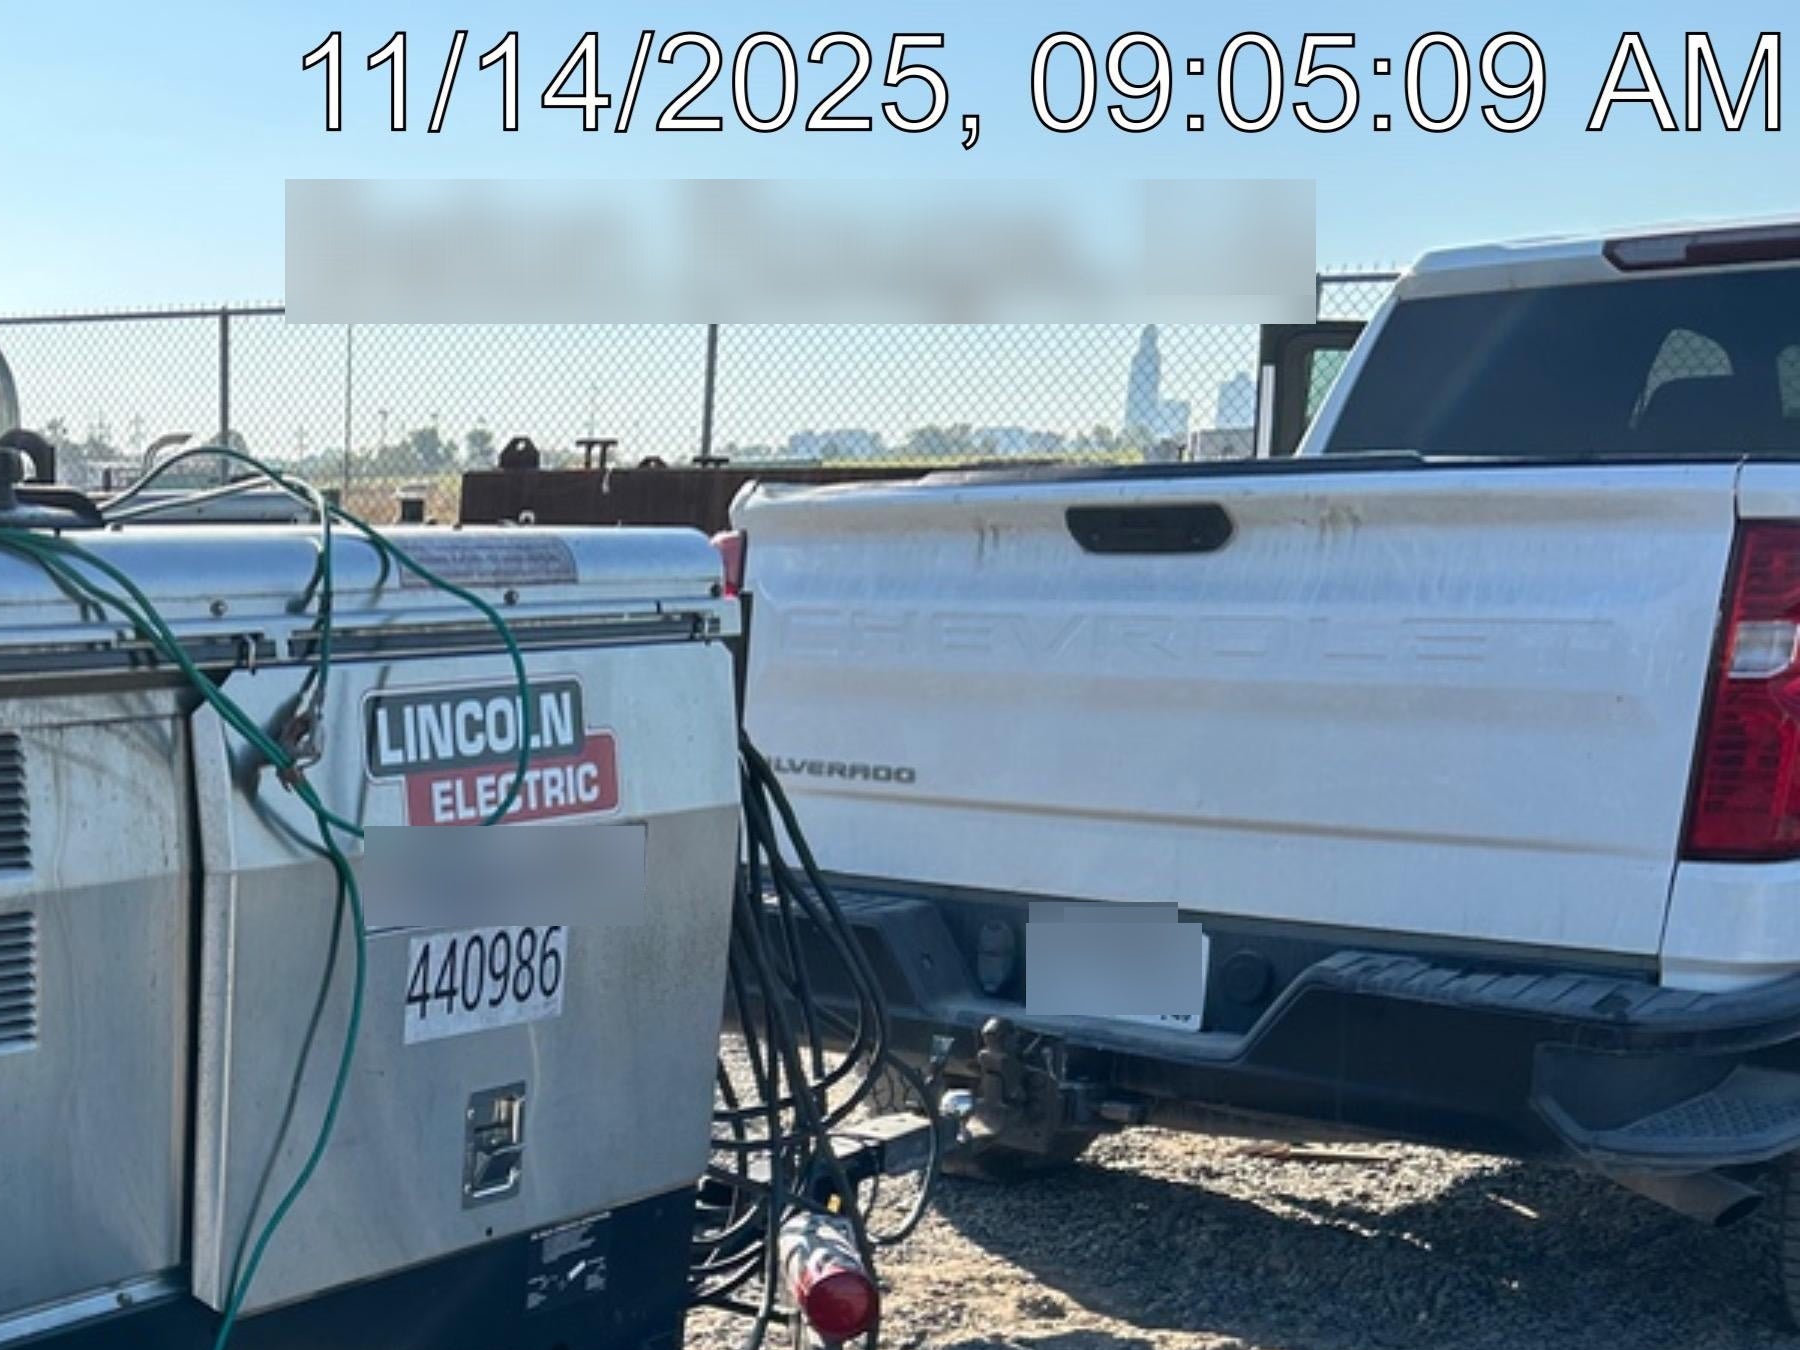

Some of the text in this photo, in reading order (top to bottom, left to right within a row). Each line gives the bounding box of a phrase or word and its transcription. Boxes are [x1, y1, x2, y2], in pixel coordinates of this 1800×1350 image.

[376, 691, 574, 766] LINCOLN
[431, 762, 599, 824] ELECTRIC
[767, 756, 916, 783] ILVERADO
[405, 925, 562, 1020] 440986
